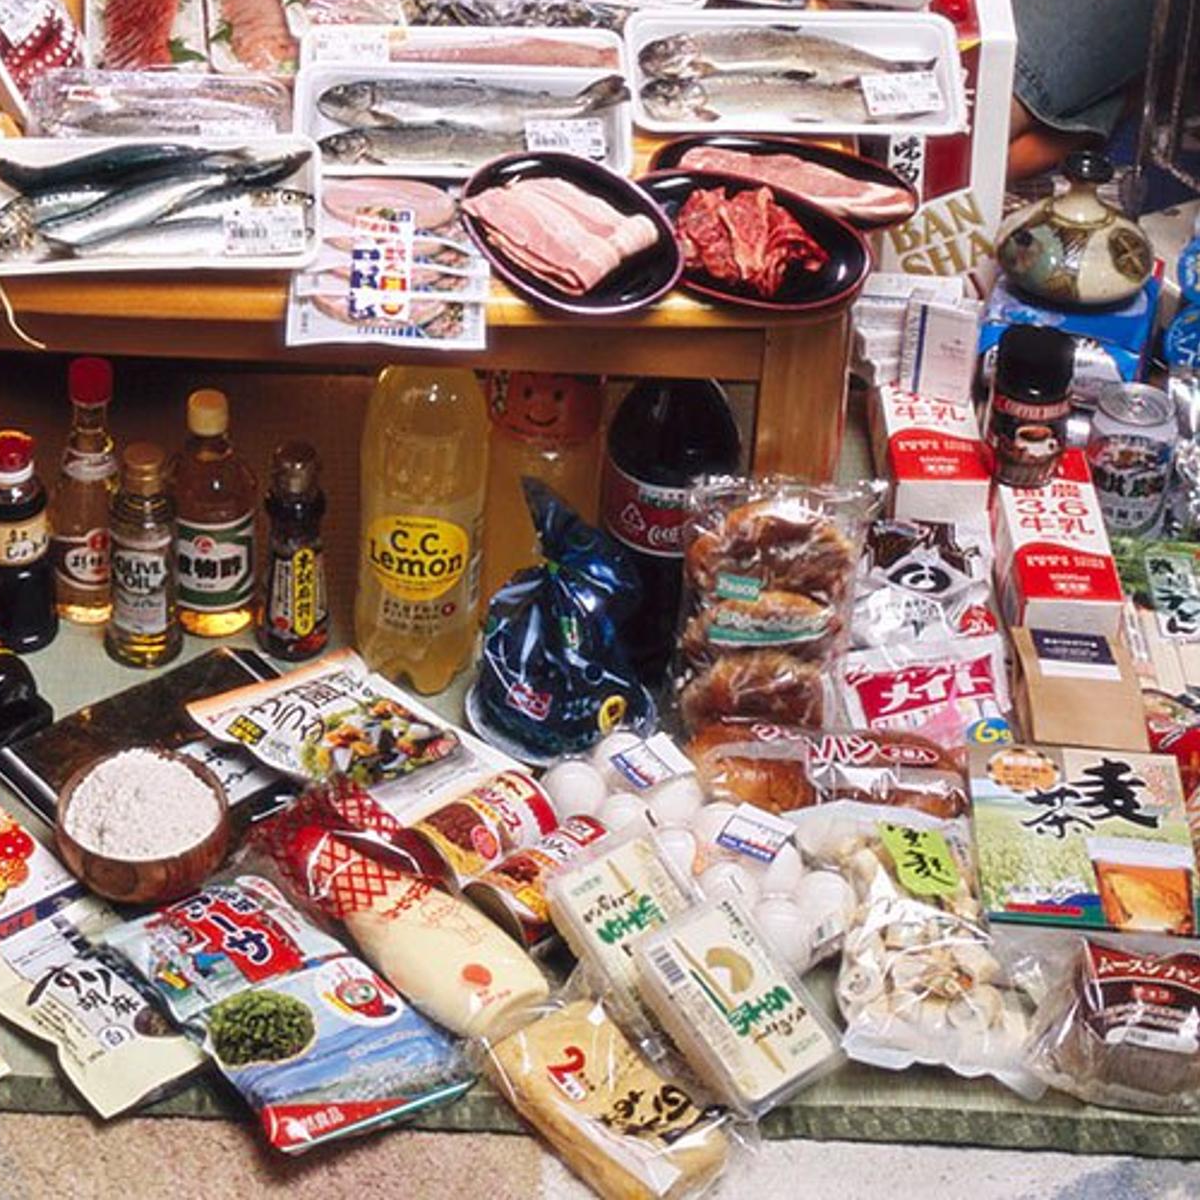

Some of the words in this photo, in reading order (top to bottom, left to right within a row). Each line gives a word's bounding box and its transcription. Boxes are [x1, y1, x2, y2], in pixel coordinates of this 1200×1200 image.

[890, 191, 985, 255] BAN
[1015, 500, 1089, 516] 3.6
[1020, 516, 1095, 535] 牛乳
[390, 529, 449, 557] C.C.
[369, 537, 463, 577] Lemon
[123, 574, 152, 589] OIL
